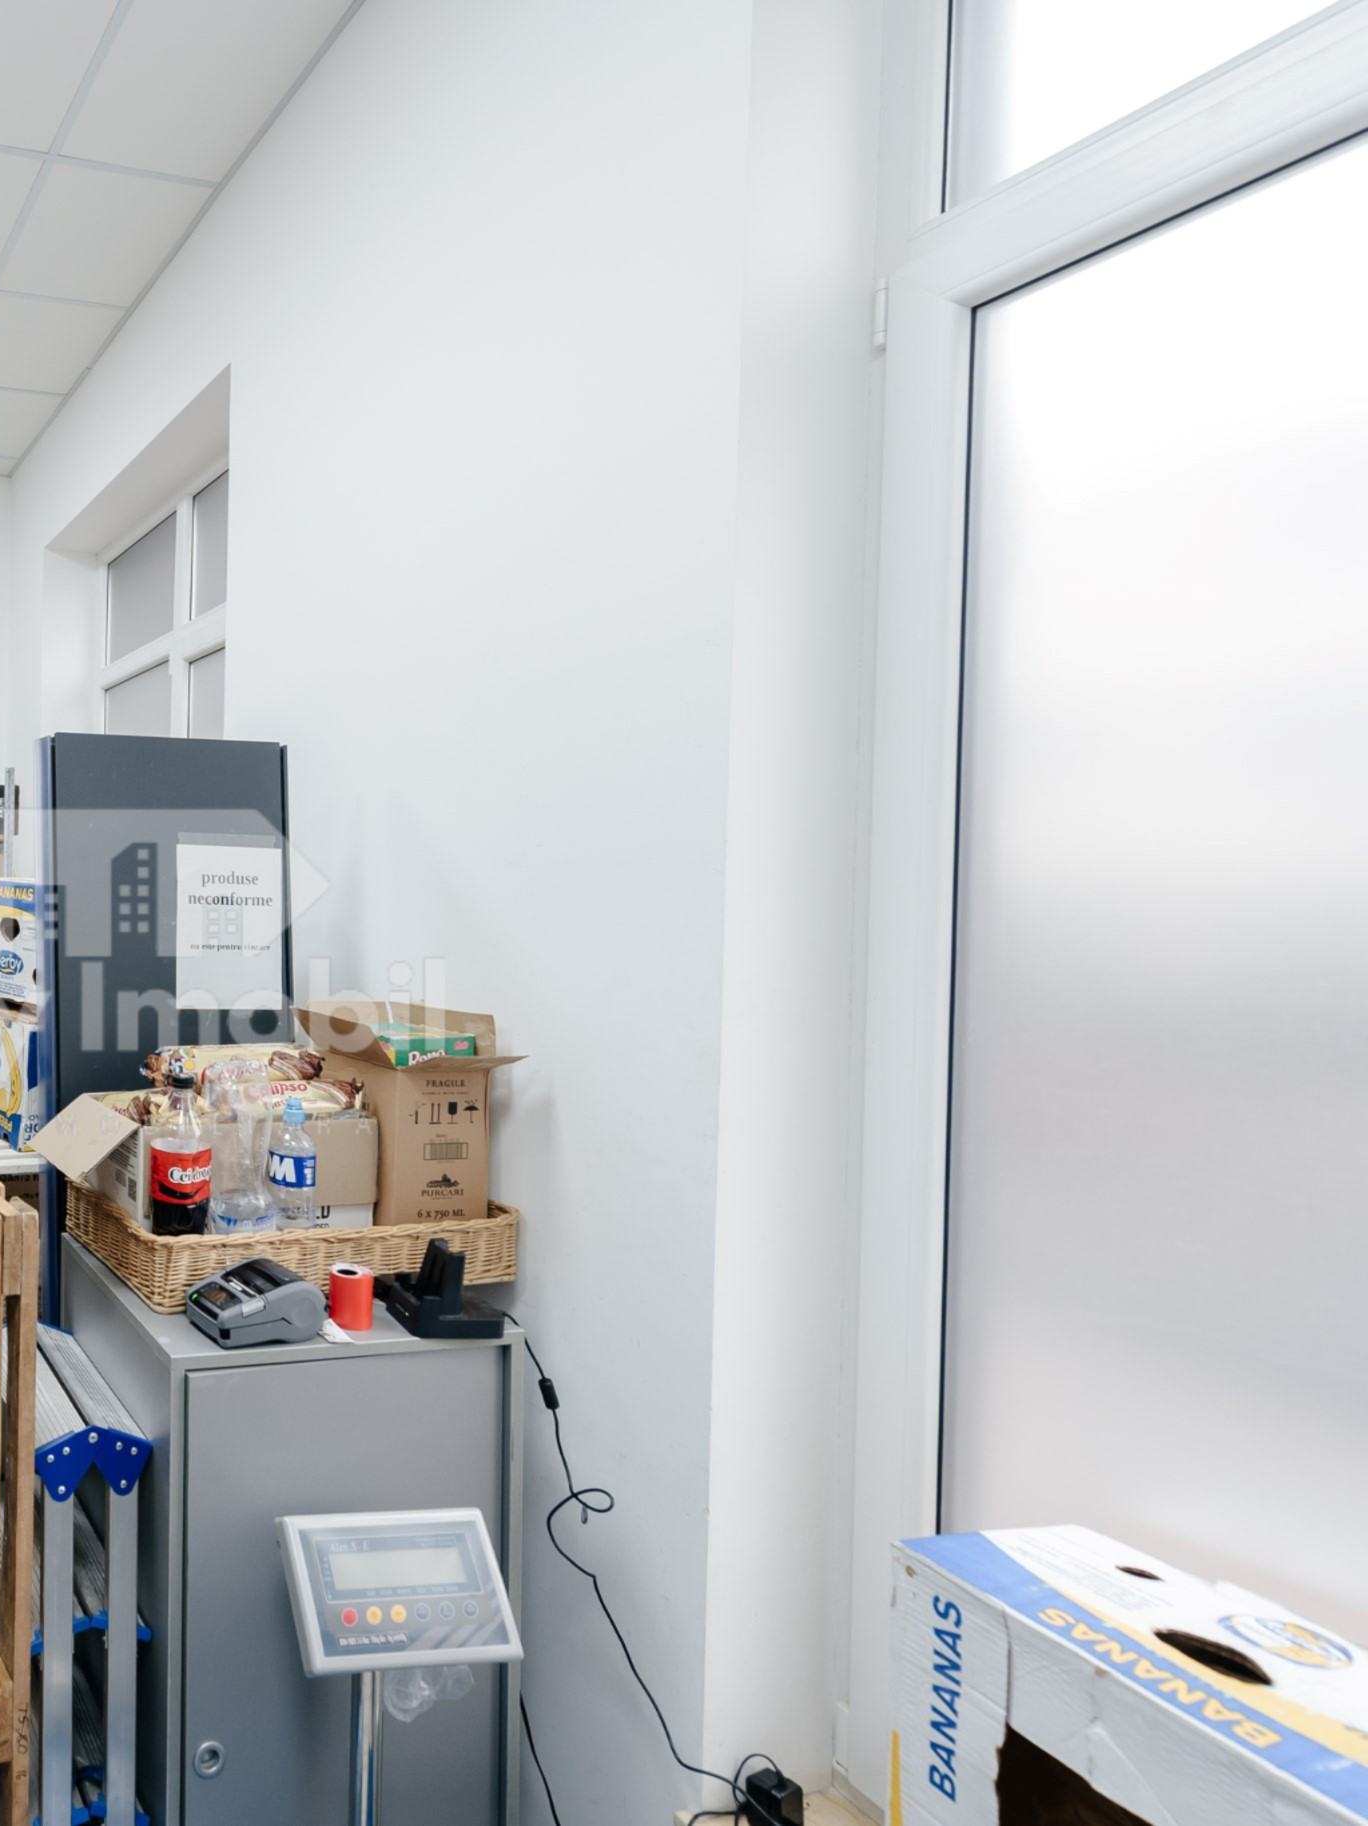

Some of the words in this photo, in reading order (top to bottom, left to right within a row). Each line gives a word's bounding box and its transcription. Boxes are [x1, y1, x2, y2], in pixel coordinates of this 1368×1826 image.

[201, 871, 259, 887] produse
[188, 892, 273, 906] neconforme
[425, 1079, 466, 1087] FRAGILE
[243, 1083, 308, 1104] Calipso
[421, 1188, 464, 1197] PURCARI
[417, 1208, 424, 1218] 6
[433, 1209, 450, 1220] 750
[451, 1208, 466, 1217] ML
[1038, 1607, 1283, 1748] BANANAS
[929, 1595, 963, 1802] BANANAS
